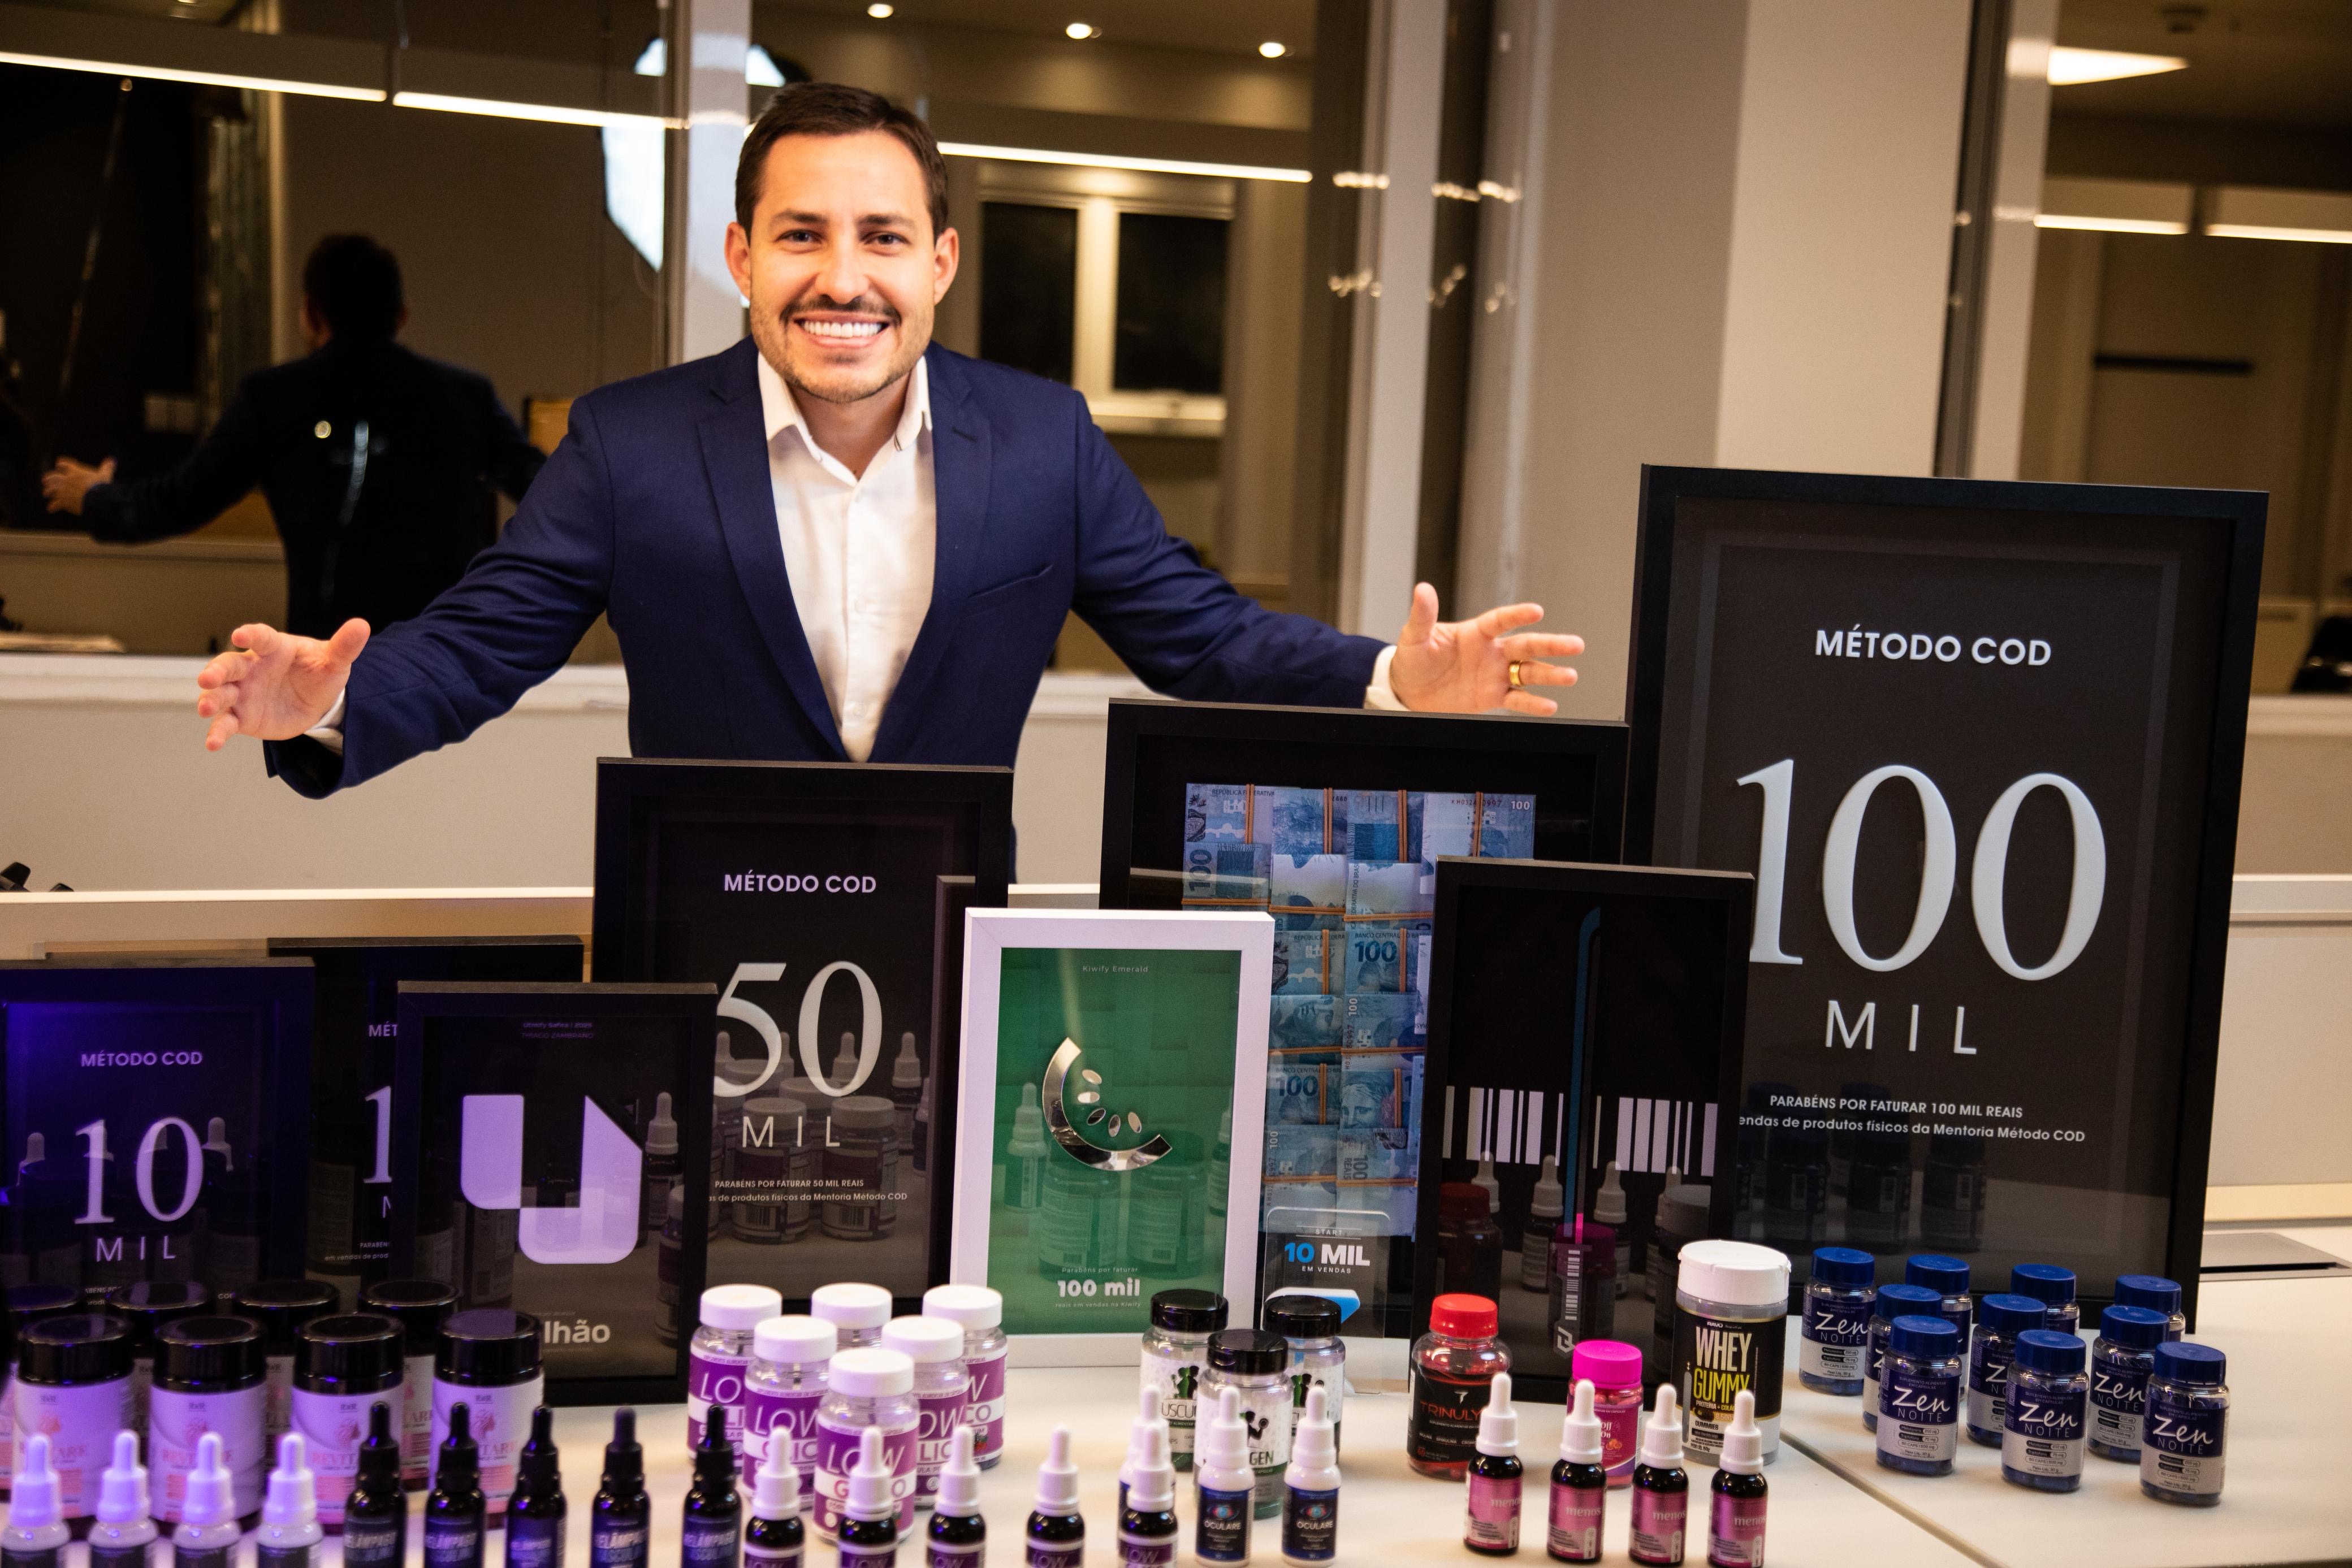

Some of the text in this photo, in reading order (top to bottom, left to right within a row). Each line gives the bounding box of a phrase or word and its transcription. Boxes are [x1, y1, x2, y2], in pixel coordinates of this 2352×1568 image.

[1815, 624, 2052, 666] MÉTODO COD
[1510, 800, 1530, 811] 100
[723, 869, 877, 894] MÉTODO COD
[1188, 849, 1212, 893] 100
[1737, 759, 2107, 981] 100
[1355, 940, 1398, 963] 100
[1082, 965, 1110, 973] Kiwify
[1348, 998, 1358, 1017] 100
[368, 1021, 398, 1037] MÉT
[713, 960, 883, 1098] 50
[1824, 1000, 1977, 1055] MIL
[81, 1049, 204, 1067] MÉTODO COD
[1276, 1075, 1318, 1097] 100
[1770, 1095, 2024, 1119] PARABÉNS POR FATURAR 100 MIL REAIS
[742, 1116, 841, 1148] MIL
[1270, 1130, 1279, 1150] 100
[1739, 1116, 2086, 1142] endas de produtos físicos da Mentoria Método COD
[74, 1116, 204, 1224] 10
[715, 1179, 756, 1188] PARABÉNS
[732, 1193, 770, 1202] produtos
[96, 1235, 176, 1262] MIL
[1284, 1242, 1371, 1267] 10 MIL
[1057, 1277, 1141, 1298] 100 mil
[544, 1319, 611, 1344] lhão
[1814, 1311, 1869, 1336] Zen
[1696, 1325, 1753, 1372] WHEY
[1820, 1331, 1862, 1344] NOITE
[700, 1373, 742, 1404] LO
[1693, 1367, 1750, 1405] GUMMY
[1892, 1384, 1951, 1413] Zen
[2094, 1371, 2146, 1403] Zen
[1897, 1407, 1943, 1423] NOITE
[2018, 1401, 2078, 1428] Zen
[2096, 1393, 2140, 1413] NOITE
[2024, 1423, 2070, 1438] NOITE
[2152, 1414, 2213, 1444] Zen
[2157, 1437, 2204, 1455] NOITE
